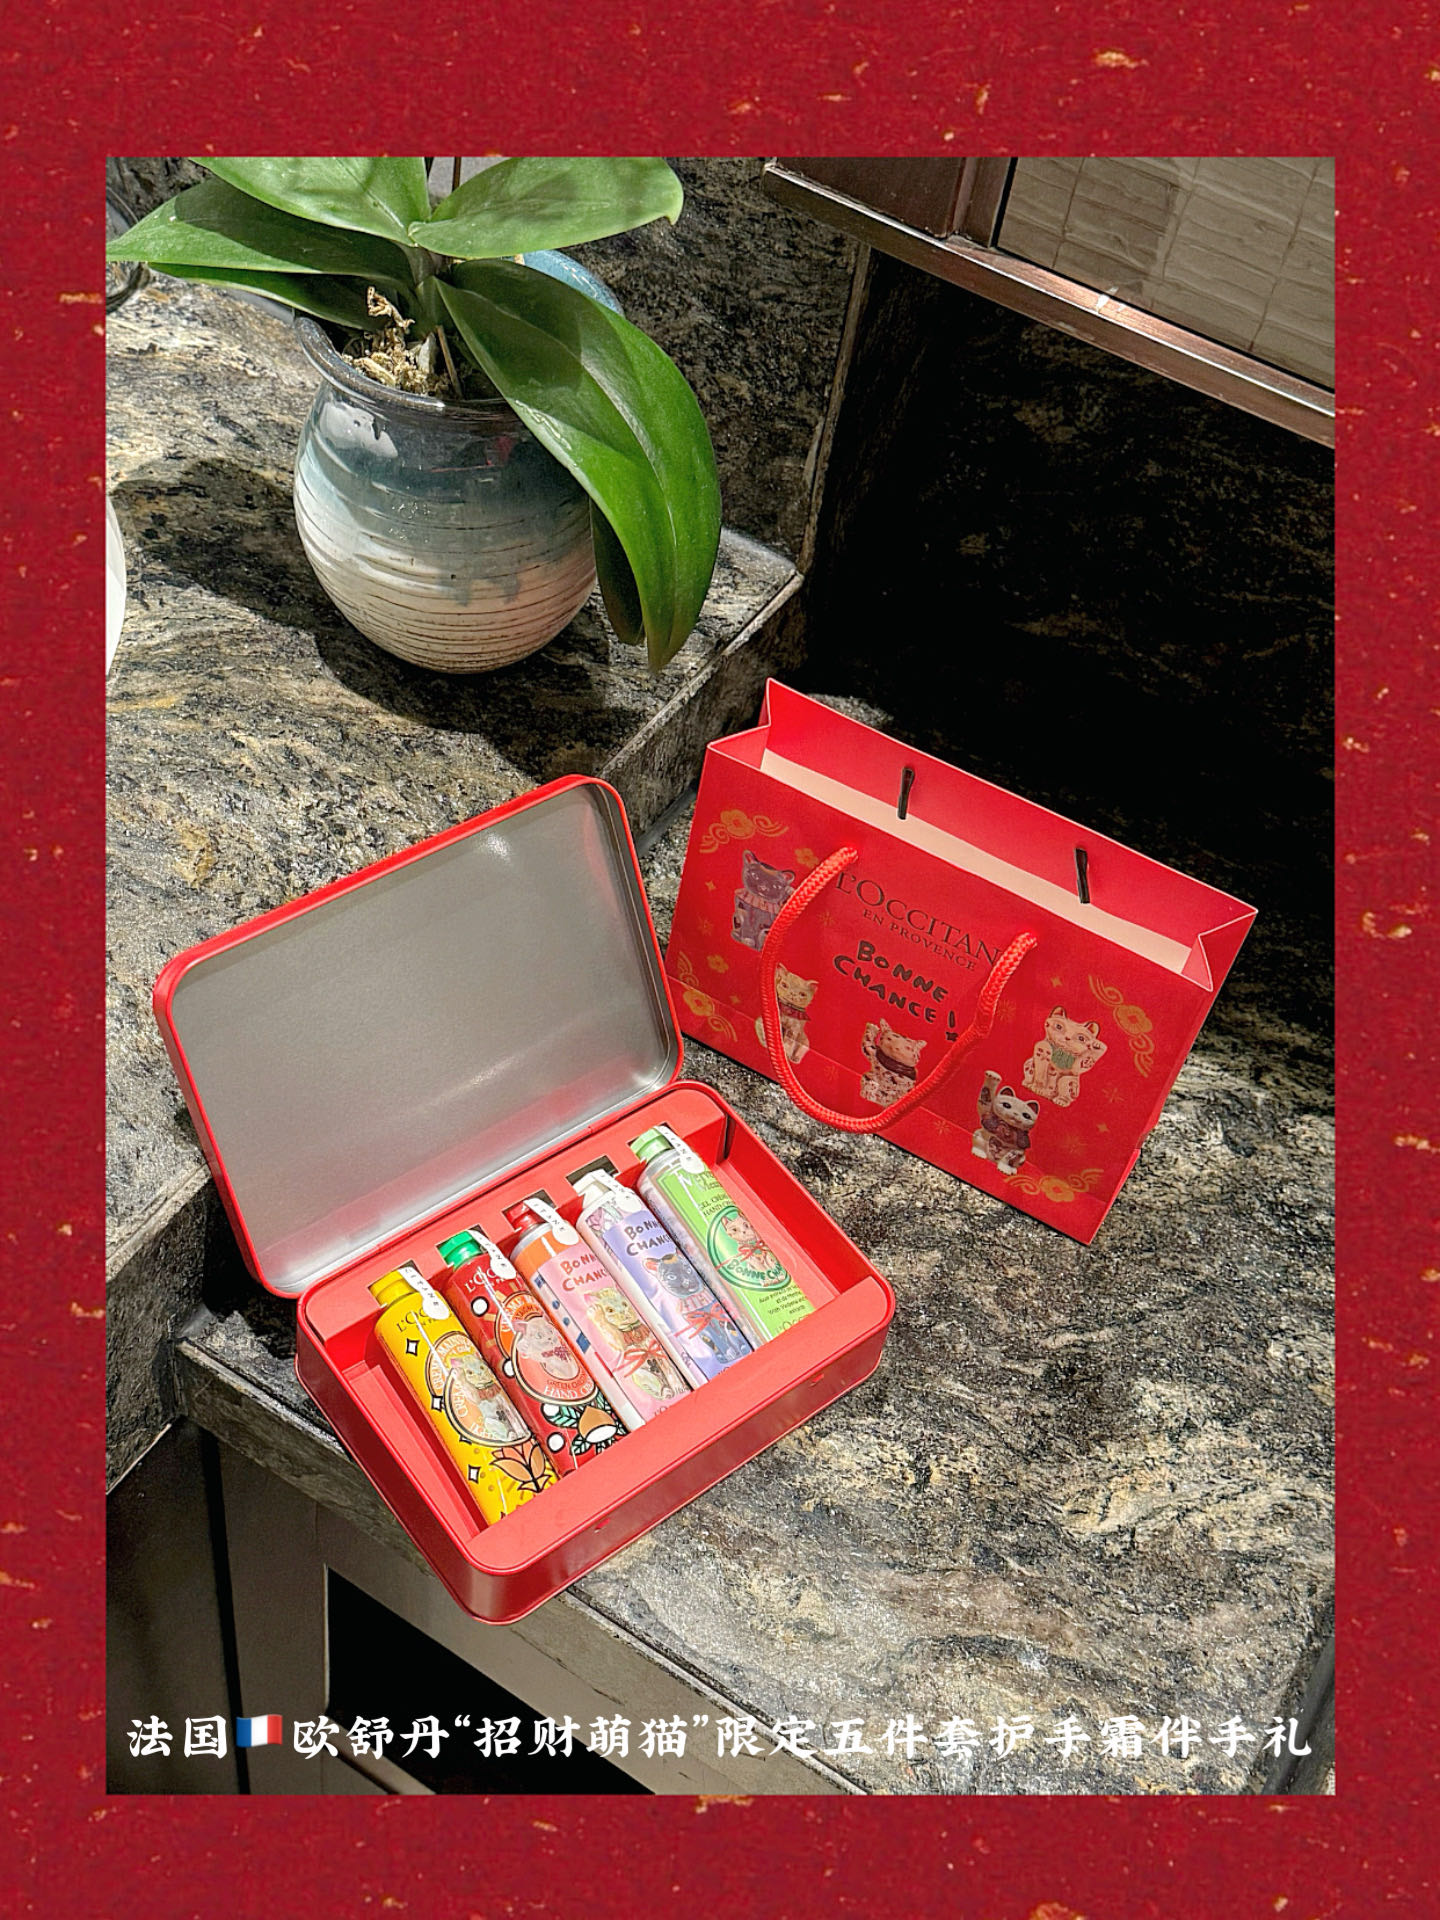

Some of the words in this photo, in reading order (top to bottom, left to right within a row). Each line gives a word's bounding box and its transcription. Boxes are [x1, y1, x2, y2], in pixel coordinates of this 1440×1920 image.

[857, 940, 948, 1002] BONNE
[863, 908, 885, 926] EN
[890, 922, 977, 972] PROVENCE
